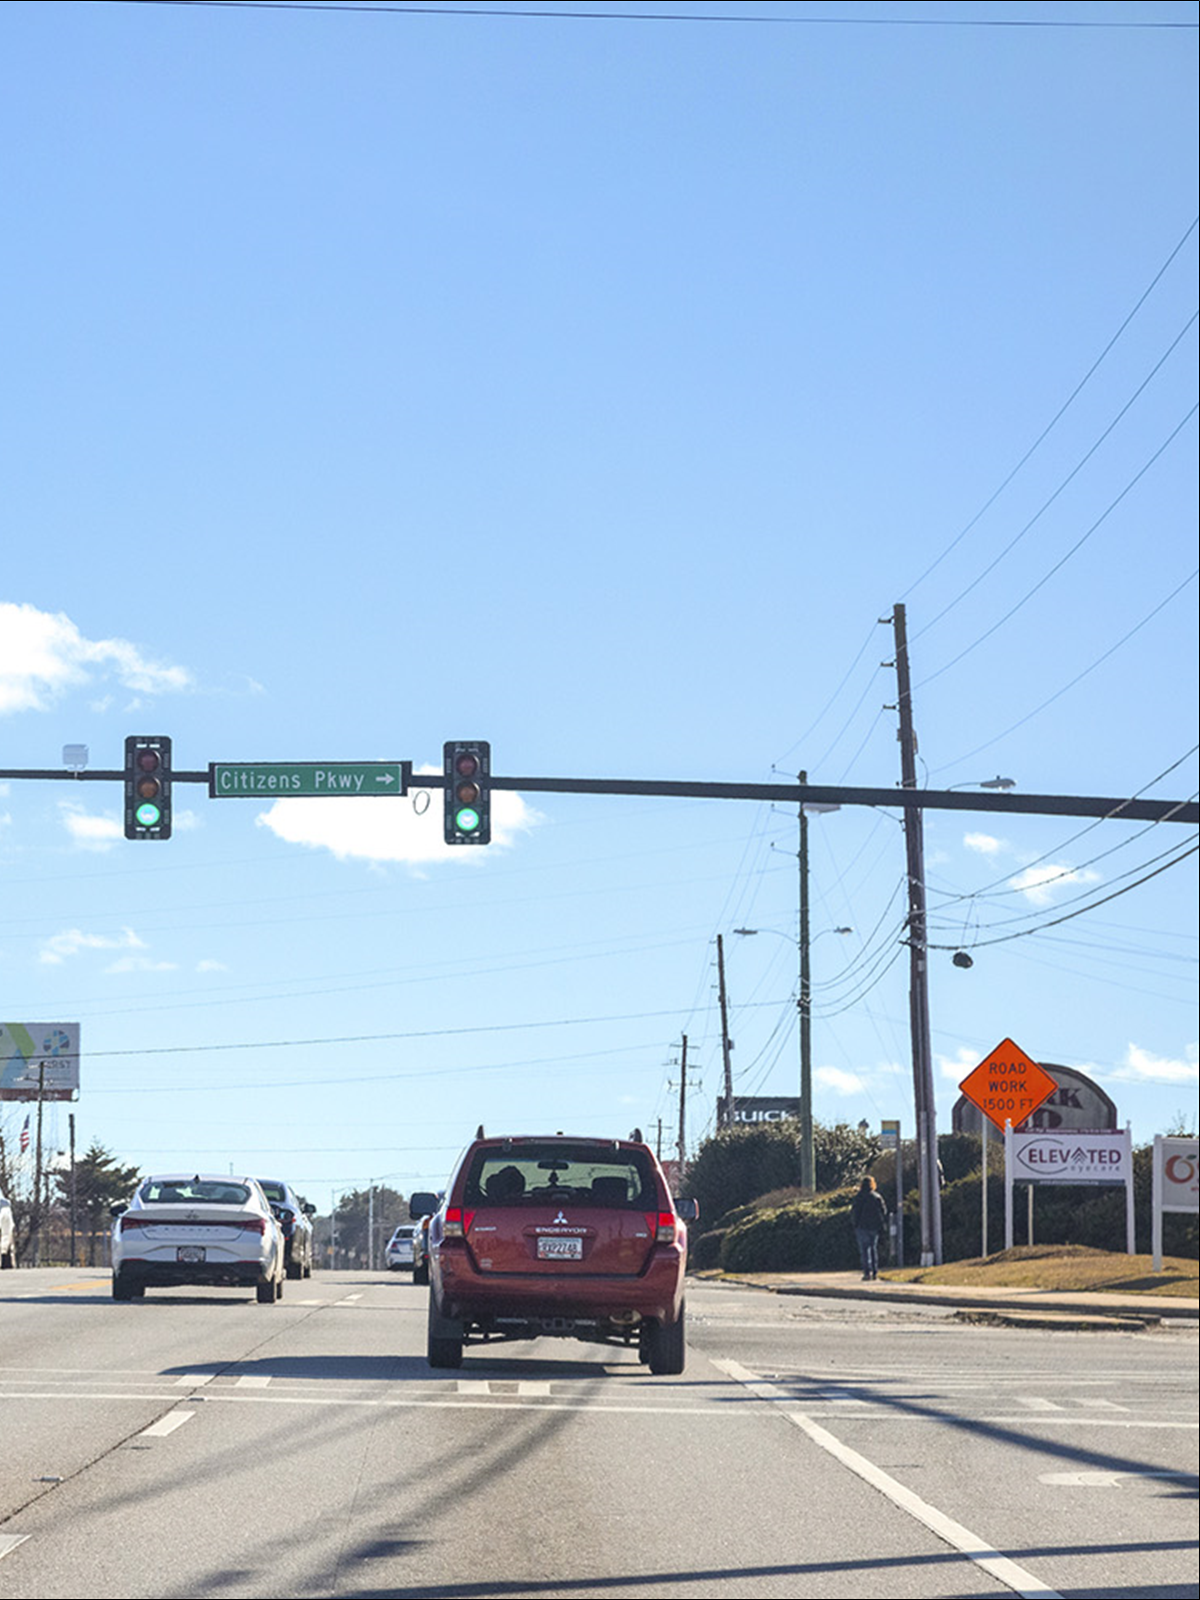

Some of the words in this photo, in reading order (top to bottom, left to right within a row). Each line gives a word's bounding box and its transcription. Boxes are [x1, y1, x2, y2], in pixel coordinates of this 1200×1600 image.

[220, 770, 301, 789] Citizens
[315, 770, 365, 791] Pkwy
[988, 1062, 1027, 1075] ROAD
[988, 1080, 1028, 1093] WORK
[983, 1098, 1015, 1111] 1500
[1019, 1098, 1033, 1110] FT
[1070, 1165, 1120, 1173] eyecare
